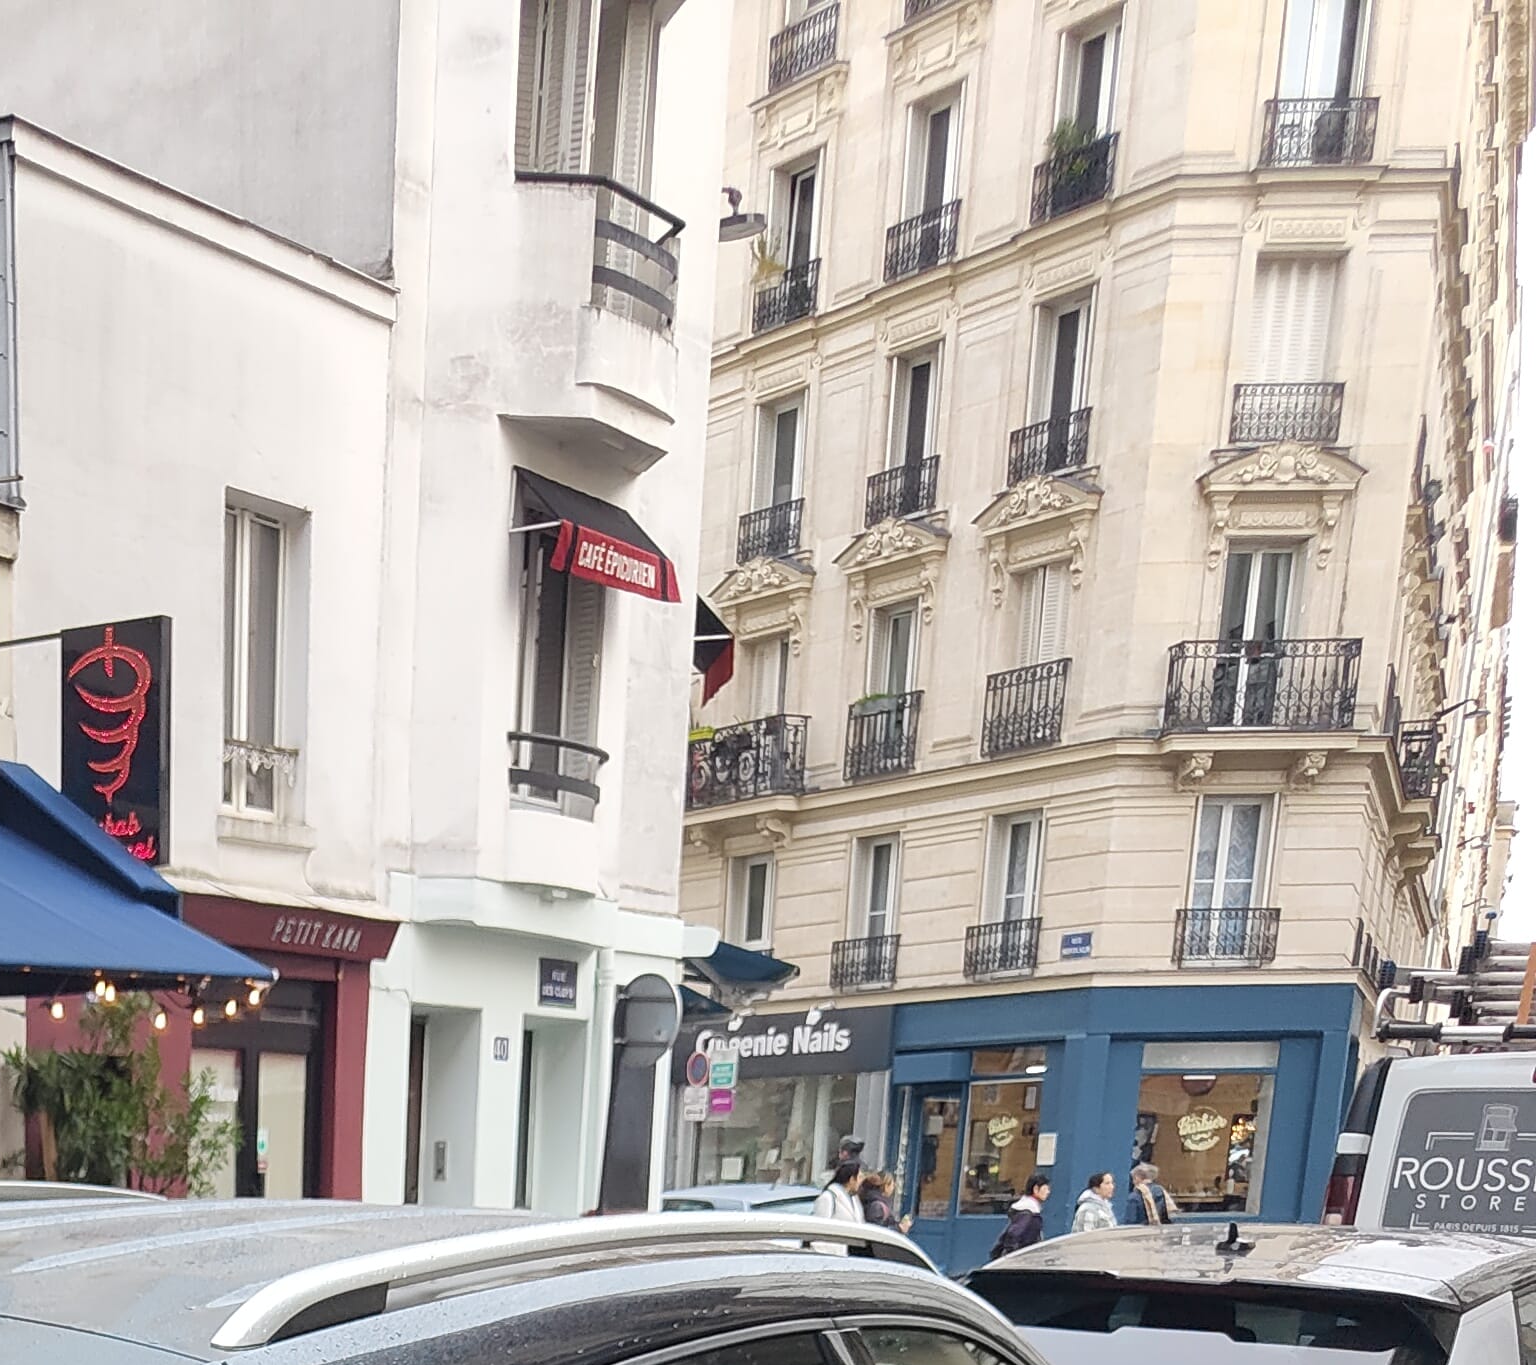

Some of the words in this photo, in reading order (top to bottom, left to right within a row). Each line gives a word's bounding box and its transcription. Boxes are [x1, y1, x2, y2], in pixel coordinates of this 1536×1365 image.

[270, 915, 323, 946] PETIT
[791, 1021, 852, 1055] Nails
[1393, 1156, 1536, 1192] ROUSS
[1433, 1221, 1460, 1232] PARIS
[1461, 1222, 1497, 1233] DEPUIS
